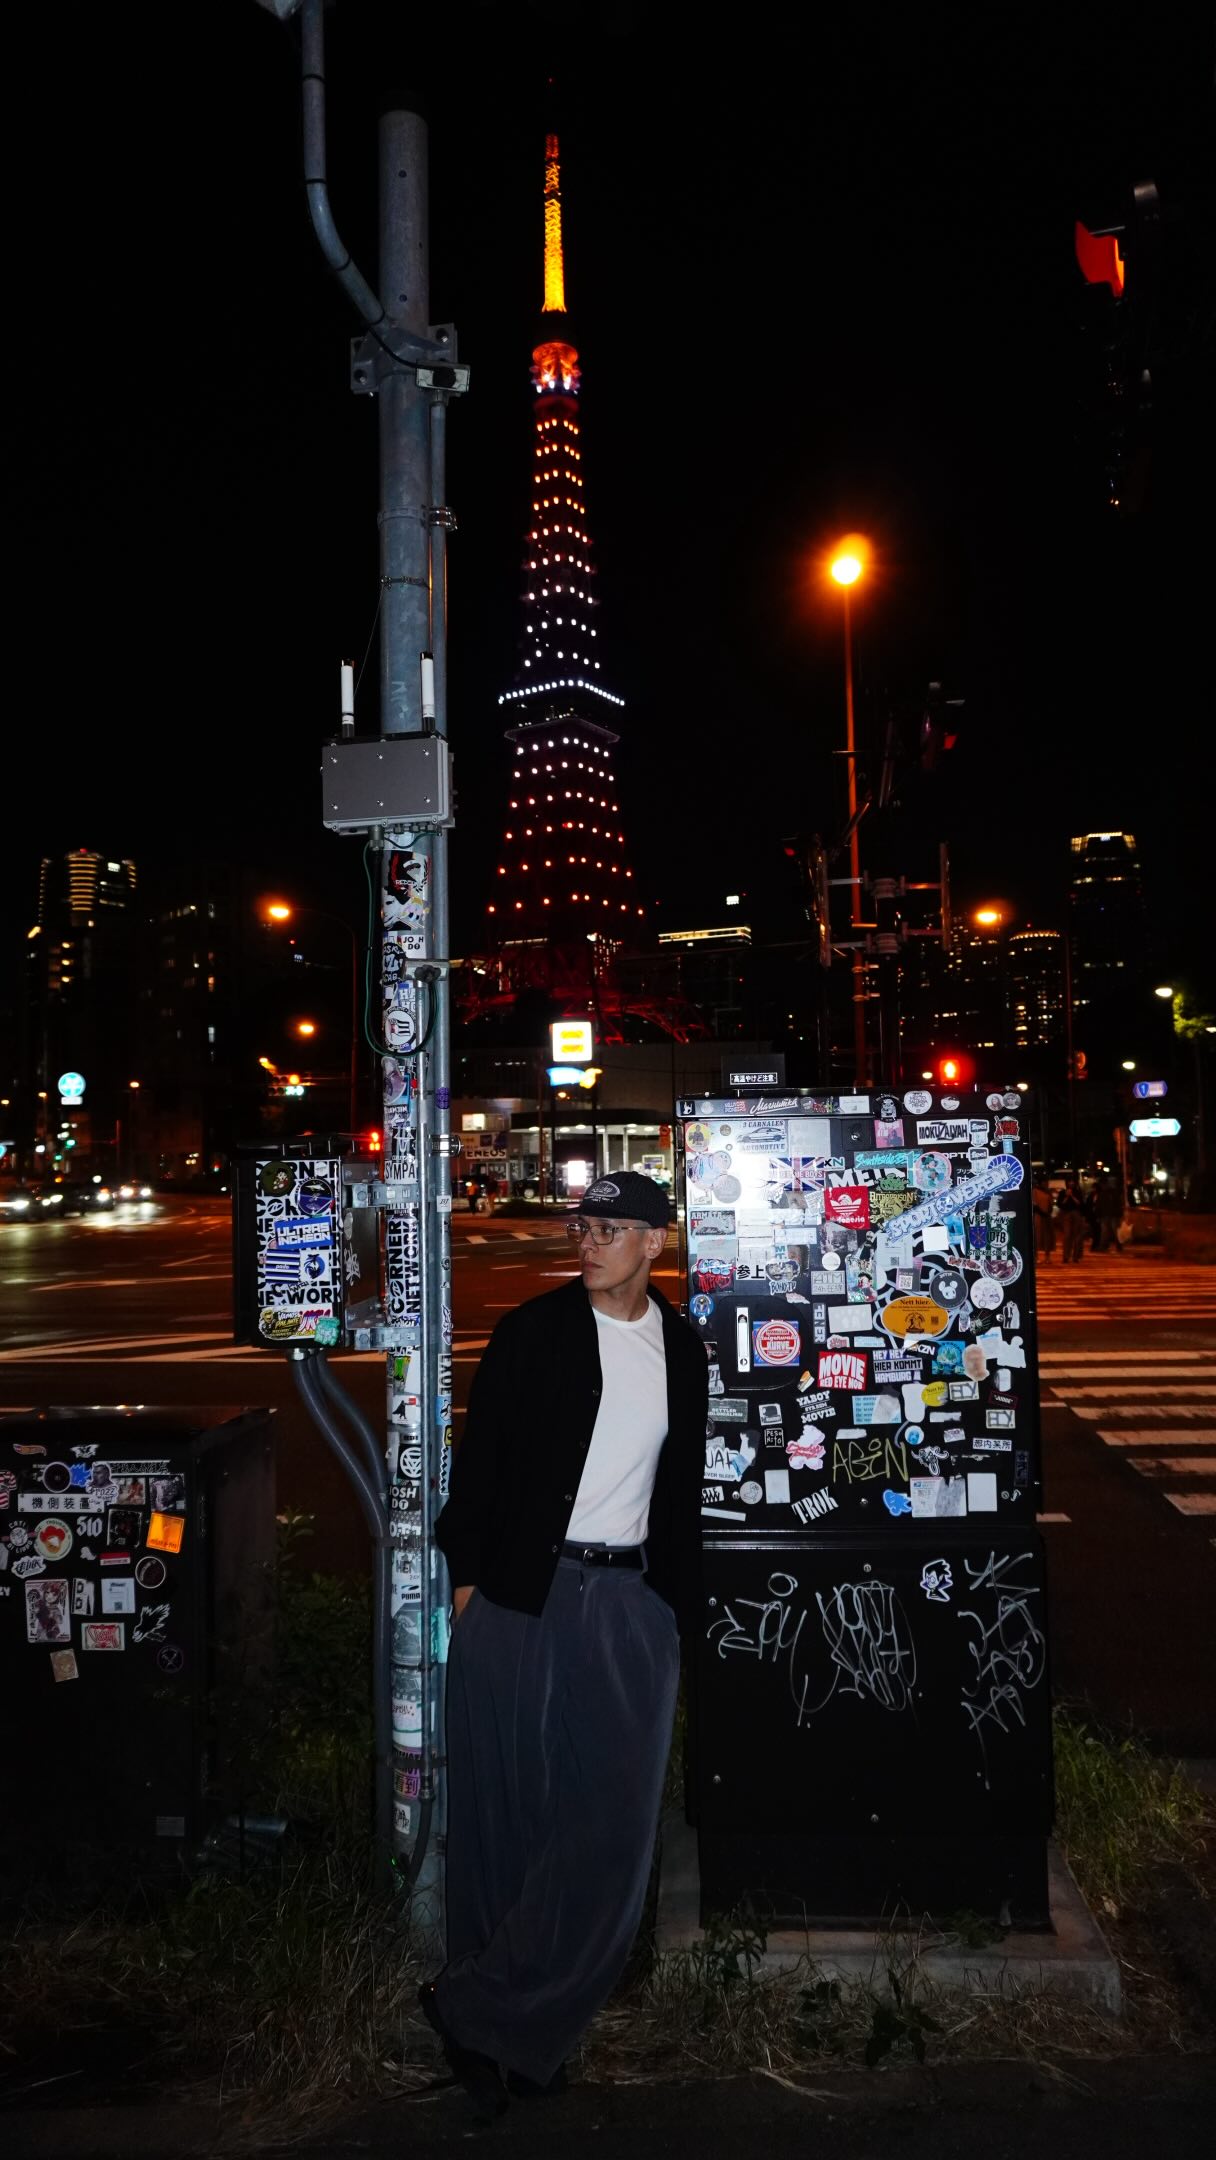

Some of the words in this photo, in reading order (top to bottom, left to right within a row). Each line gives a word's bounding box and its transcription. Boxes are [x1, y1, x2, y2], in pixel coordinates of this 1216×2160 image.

[467, 1149, 506, 1158] ENEOS
[385, 1162, 415, 1180] SYMPA
[277, 1222, 330, 1236] ULTRAS
[278, 1232, 331, 1245] INCHEON
[737, 1265, 765, 1280] 参上
[873, 1350, 887, 1360] HEY
[819, 1353, 865, 1383] MOVIE
[874, 1360, 892, 1371] HIER
[894, 1359, 922, 1369] KOMMT
[820, 1376, 833, 1387] RED
[834, 1376, 847, 1389] EYE
[875, 1371, 912, 1383] HAMBURG
[796, 1390, 830, 1406] YABOY
[801, 1407, 836, 1424] MOVIE
[76, 1516, 103, 1538] 510
